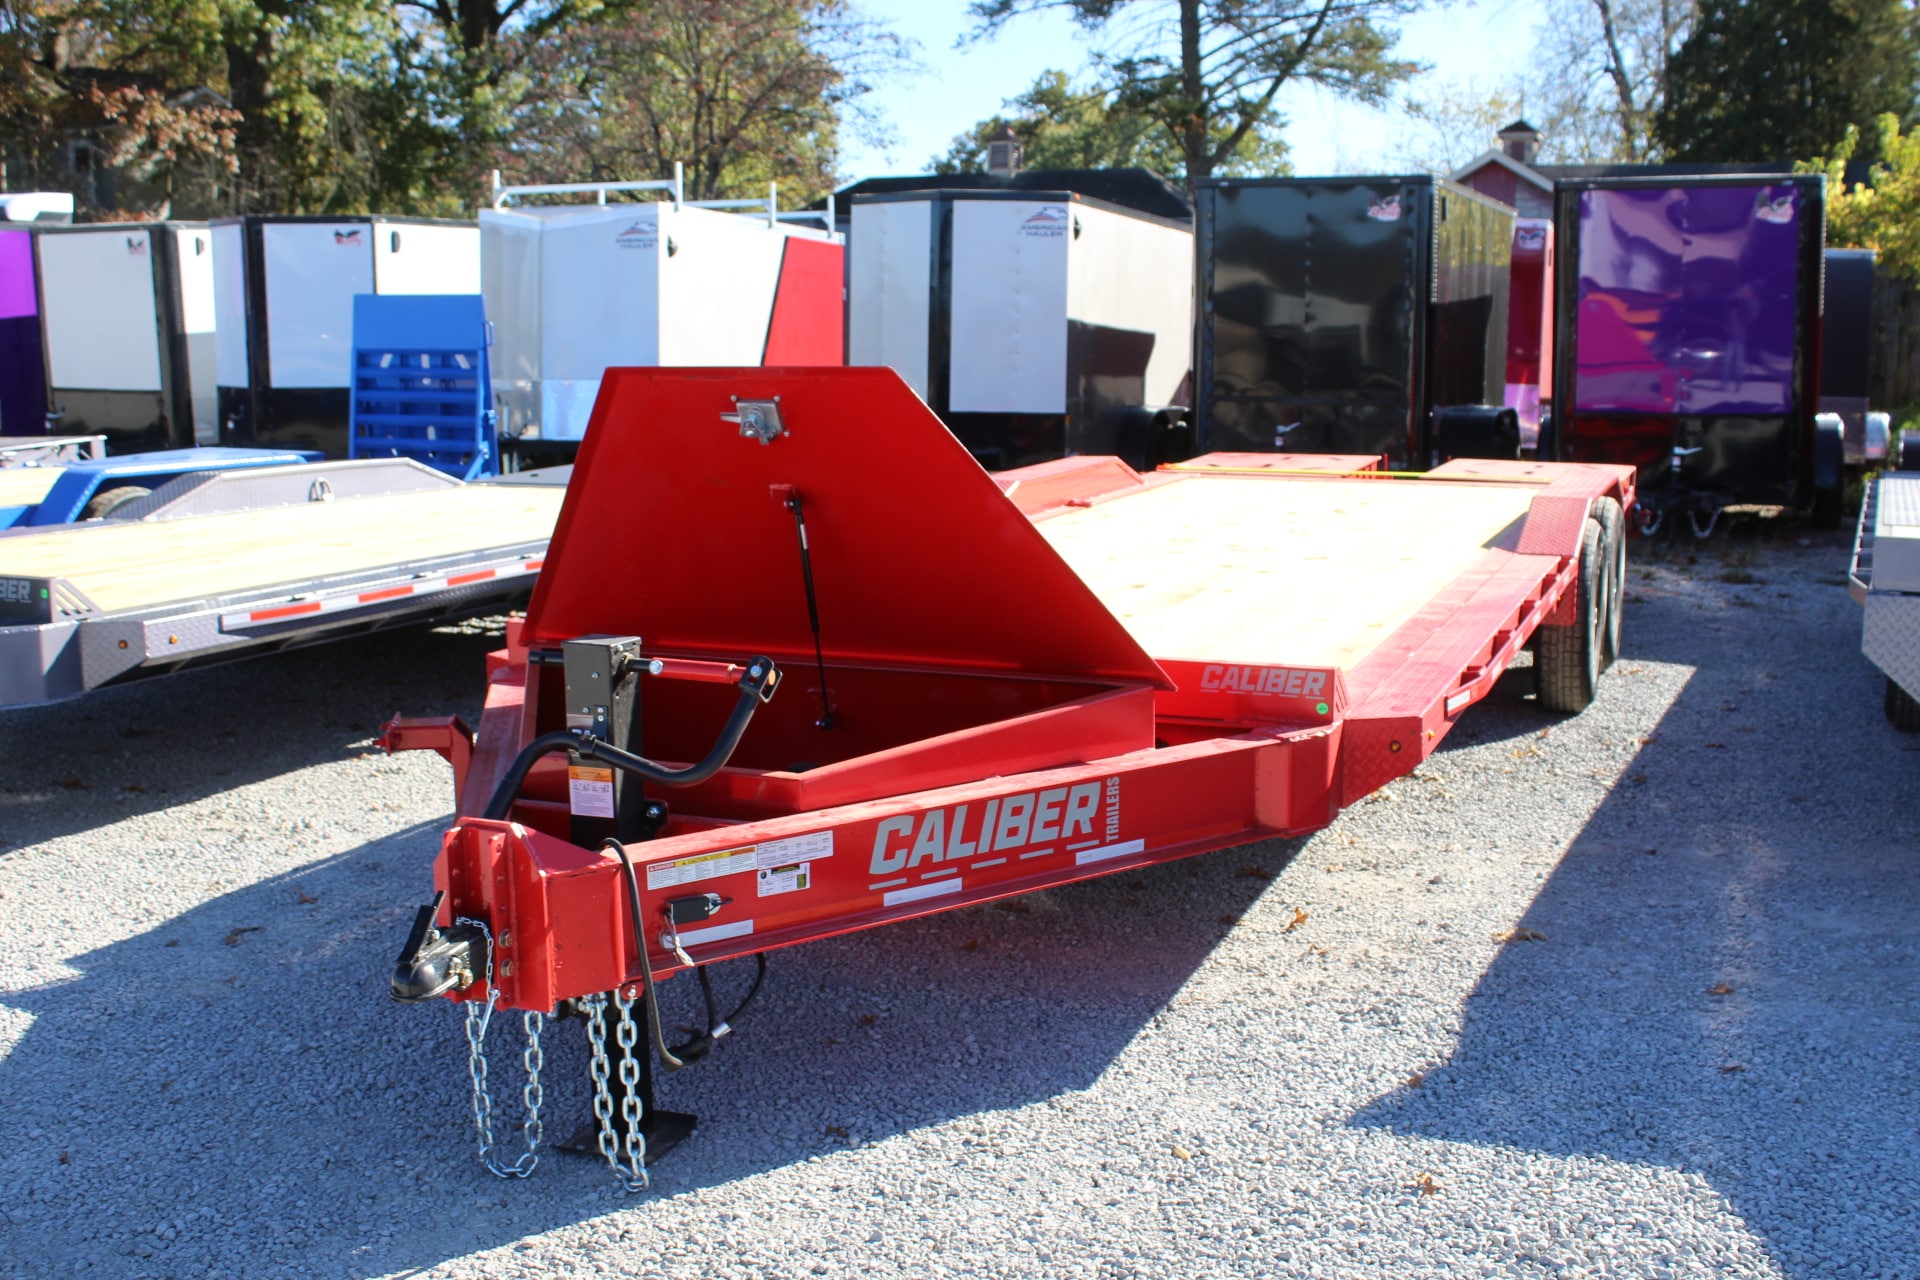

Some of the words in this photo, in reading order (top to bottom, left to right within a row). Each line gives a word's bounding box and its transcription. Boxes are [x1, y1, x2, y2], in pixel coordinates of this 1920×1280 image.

[1201, 665, 1326, 696] CALIBER
[869, 782, 1101, 875] CALIBER
[1106, 776, 1120, 842] TRAILERS
